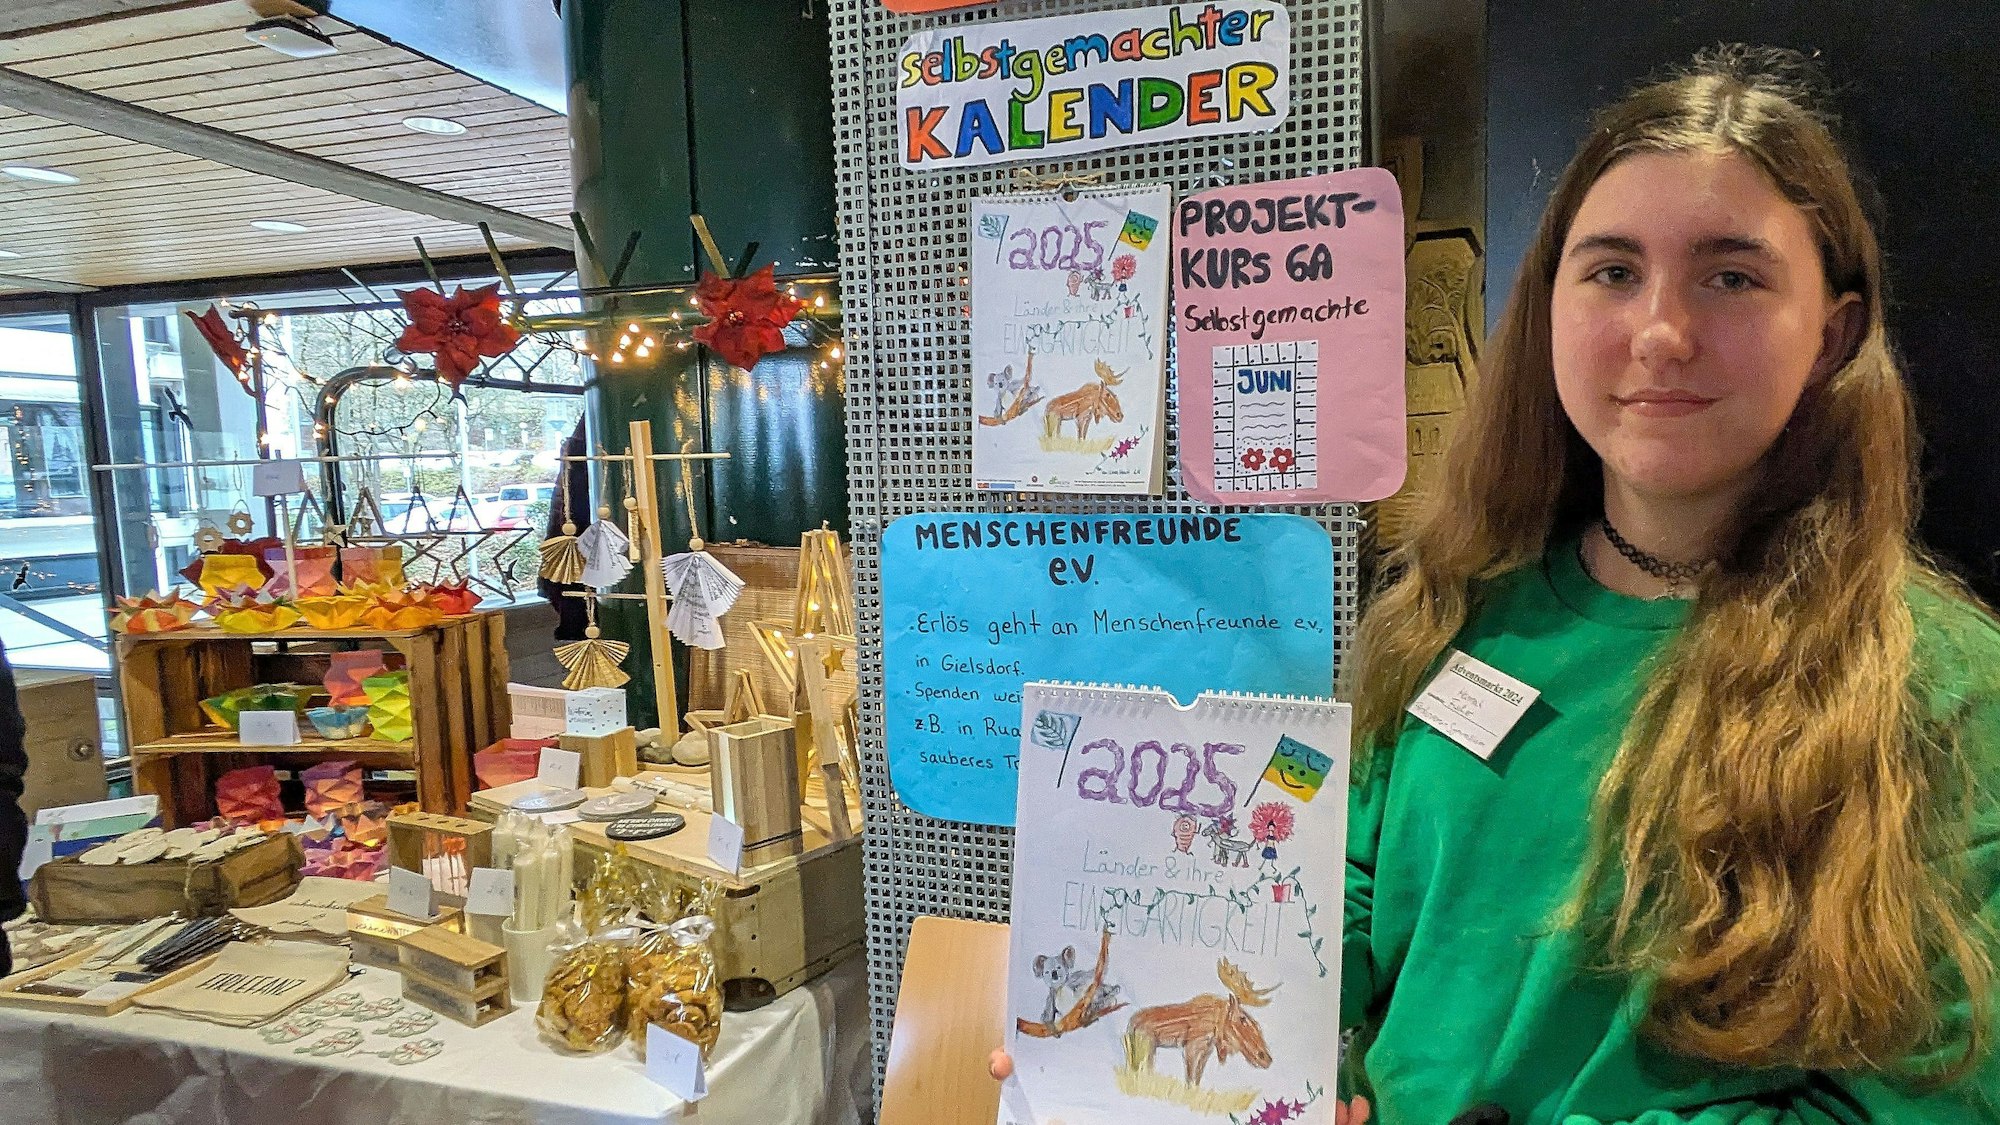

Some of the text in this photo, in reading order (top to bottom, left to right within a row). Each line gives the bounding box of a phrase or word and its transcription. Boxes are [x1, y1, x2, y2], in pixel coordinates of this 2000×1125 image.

[901, 5, 1274, 101] selbstgemachter
[906, 62, 1278, 162] KALENDER
[1181, 192, 1376, 237] PROJEKT-
[1008, 220, 1108, 271] 2025
[1181, 243, 1333, 289] KURS 6A
[1184, 296, 1370, 340] Selbstgemachte
[1237, 369, 1292, 394] JUNI
[916, 516, 1242, 550] MENSCHENFREUNDE
[918, 611, 969, 633] Erlös
[988, 609, 1041, 645] geht
[1052, 625, 1078, 635] an
[1094, 608, 1281, 634] Menschenfreunde
[916, 654, 1025, 676] in Gielsdorf.
[1450, 663, 1504, 694] Adventsmarkt
[1502, 687, 1524, 704] 2024
[915, 682, 1024, 703] Spenden wei
[914, 713, 1021, 737] z.B. in Rua
[920, 748, 1020, 770] sauberes Tr
[1077, 738, 1246, 817] 2025
[1083, 840, 1224, 883] Länder & ihre
